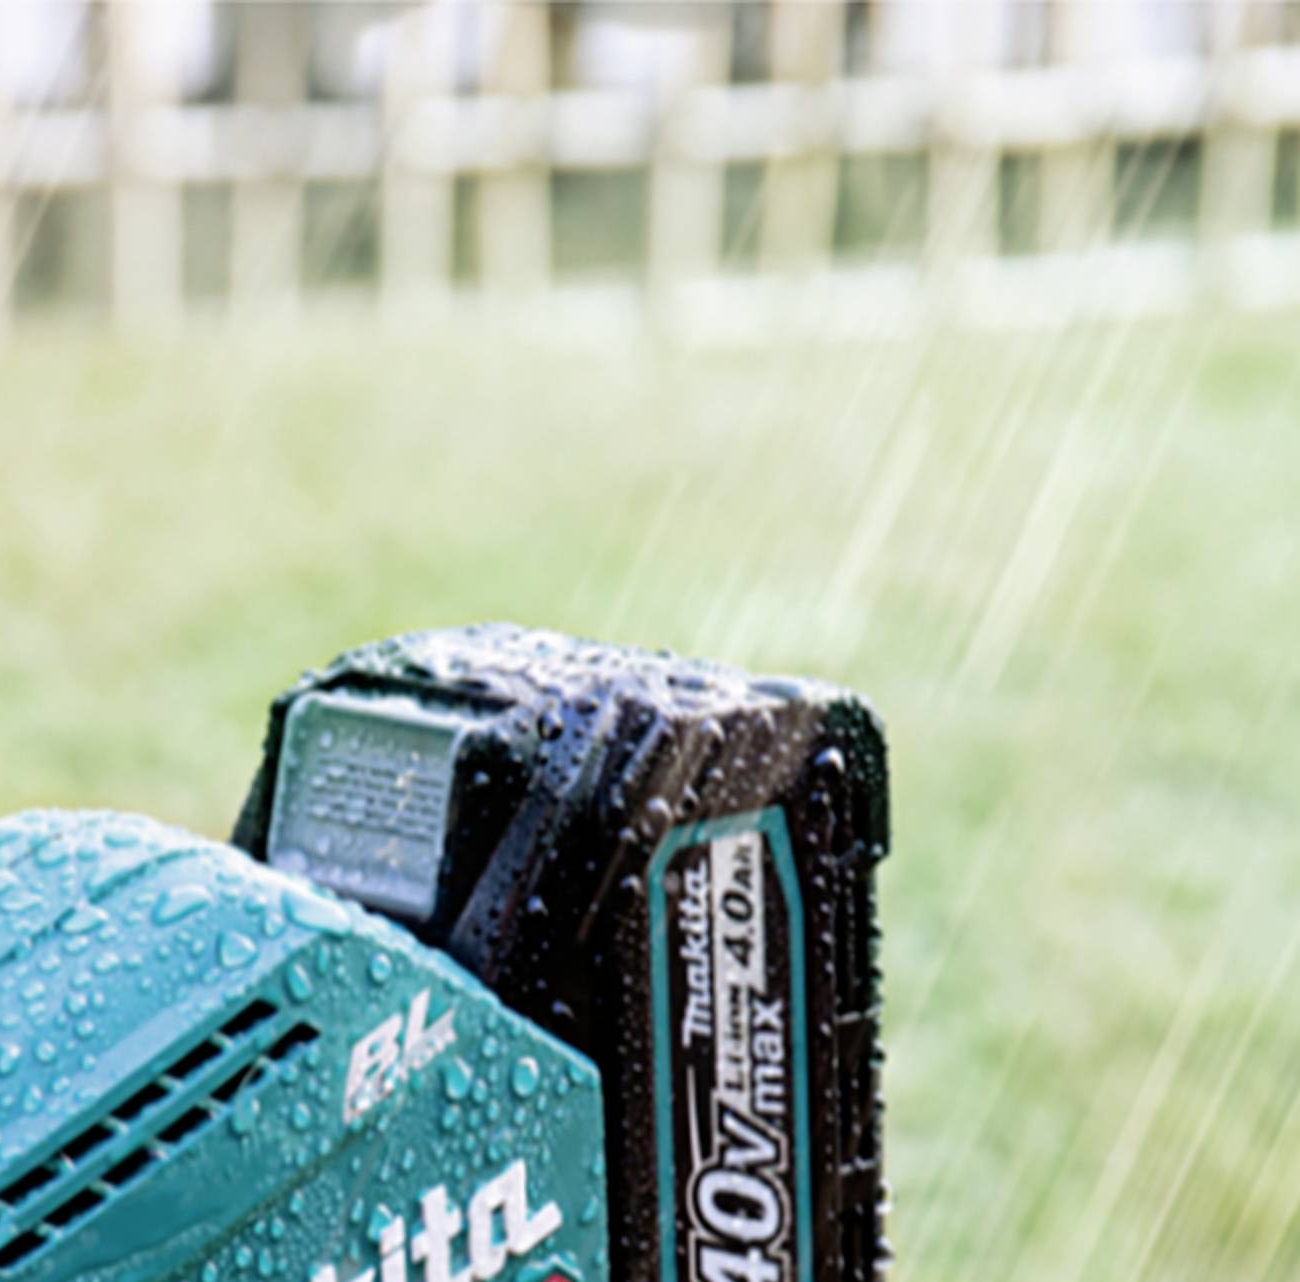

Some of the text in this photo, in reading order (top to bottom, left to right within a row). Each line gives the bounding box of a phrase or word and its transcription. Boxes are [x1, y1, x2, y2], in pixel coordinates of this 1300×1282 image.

[678, 861, 712, 1048] makita
[721, 844, 755, 968] 4.0Ah
[343, 987, 456, 1125] BL
